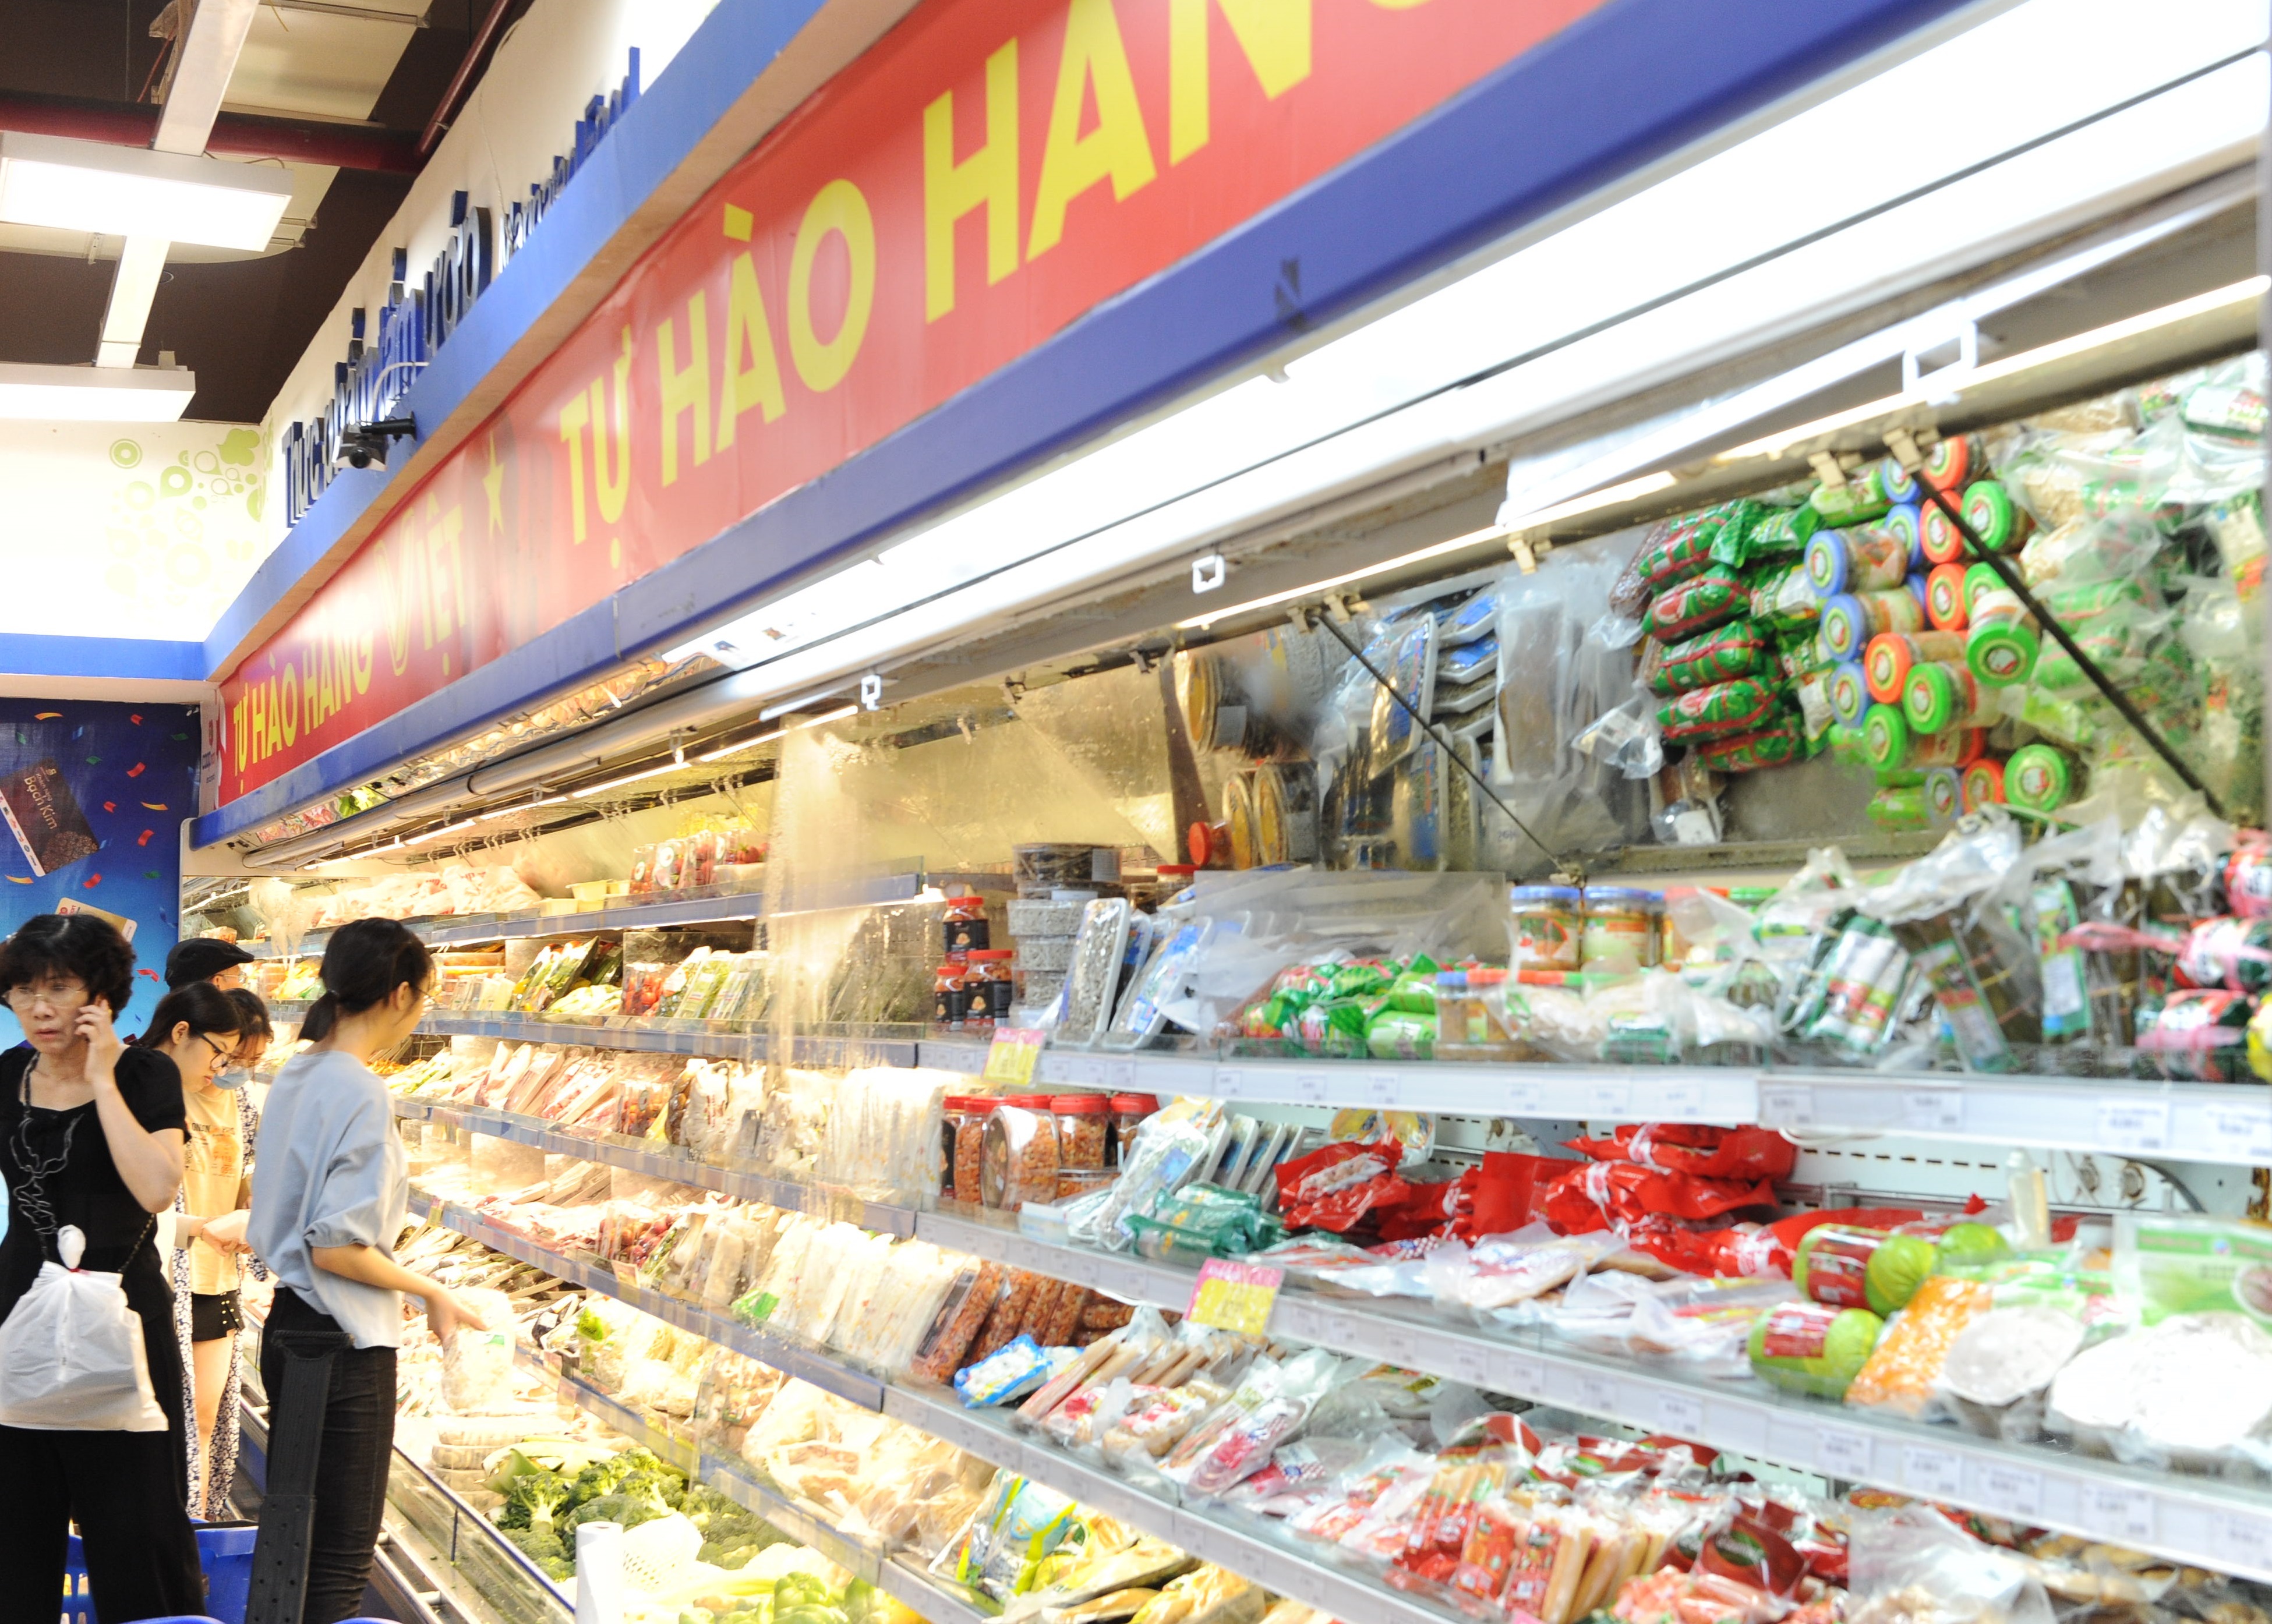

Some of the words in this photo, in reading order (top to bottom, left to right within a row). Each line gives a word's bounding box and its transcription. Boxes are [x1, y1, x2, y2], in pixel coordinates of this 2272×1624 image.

[560, 324, 631, 569] TỰ
[657, 178, 876, 488] HÀO
[234, 682, 249, 795] TỰ
[252, 650, 298, 765] HÀO
[24, 775, 47, 806] Bạch
[40, 804, 57, 830] Kim
